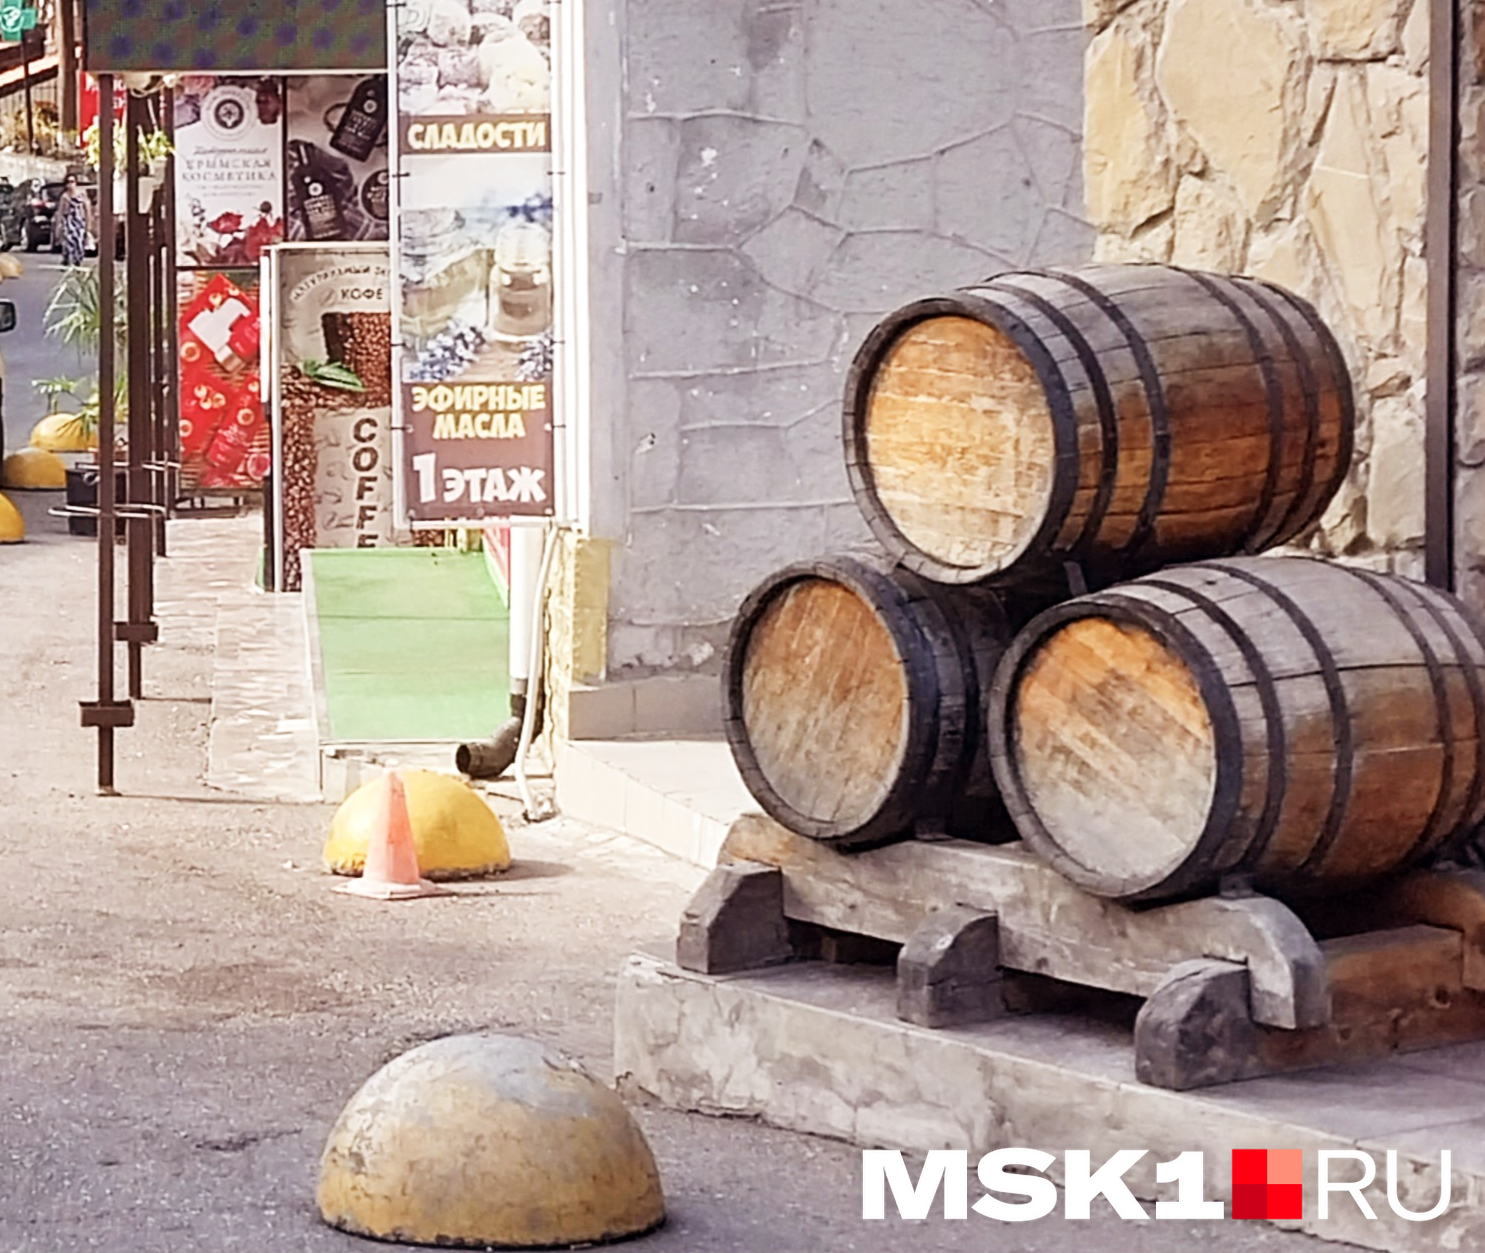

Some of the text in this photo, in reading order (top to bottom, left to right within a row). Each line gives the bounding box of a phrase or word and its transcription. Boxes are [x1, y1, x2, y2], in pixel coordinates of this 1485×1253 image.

[407, 121, 546, 150] СЛАДОСТИ
[182, 172, 277, 181] КОСМЕТИКА
[340, 288, 383, 300] КОФЕ
[412, 384, 546, 412] ЭФИРНЫЕ
[432, 412, 526, 439] МАСЛА
[412, 452, 547, 503] 1 ЭТАЖ
